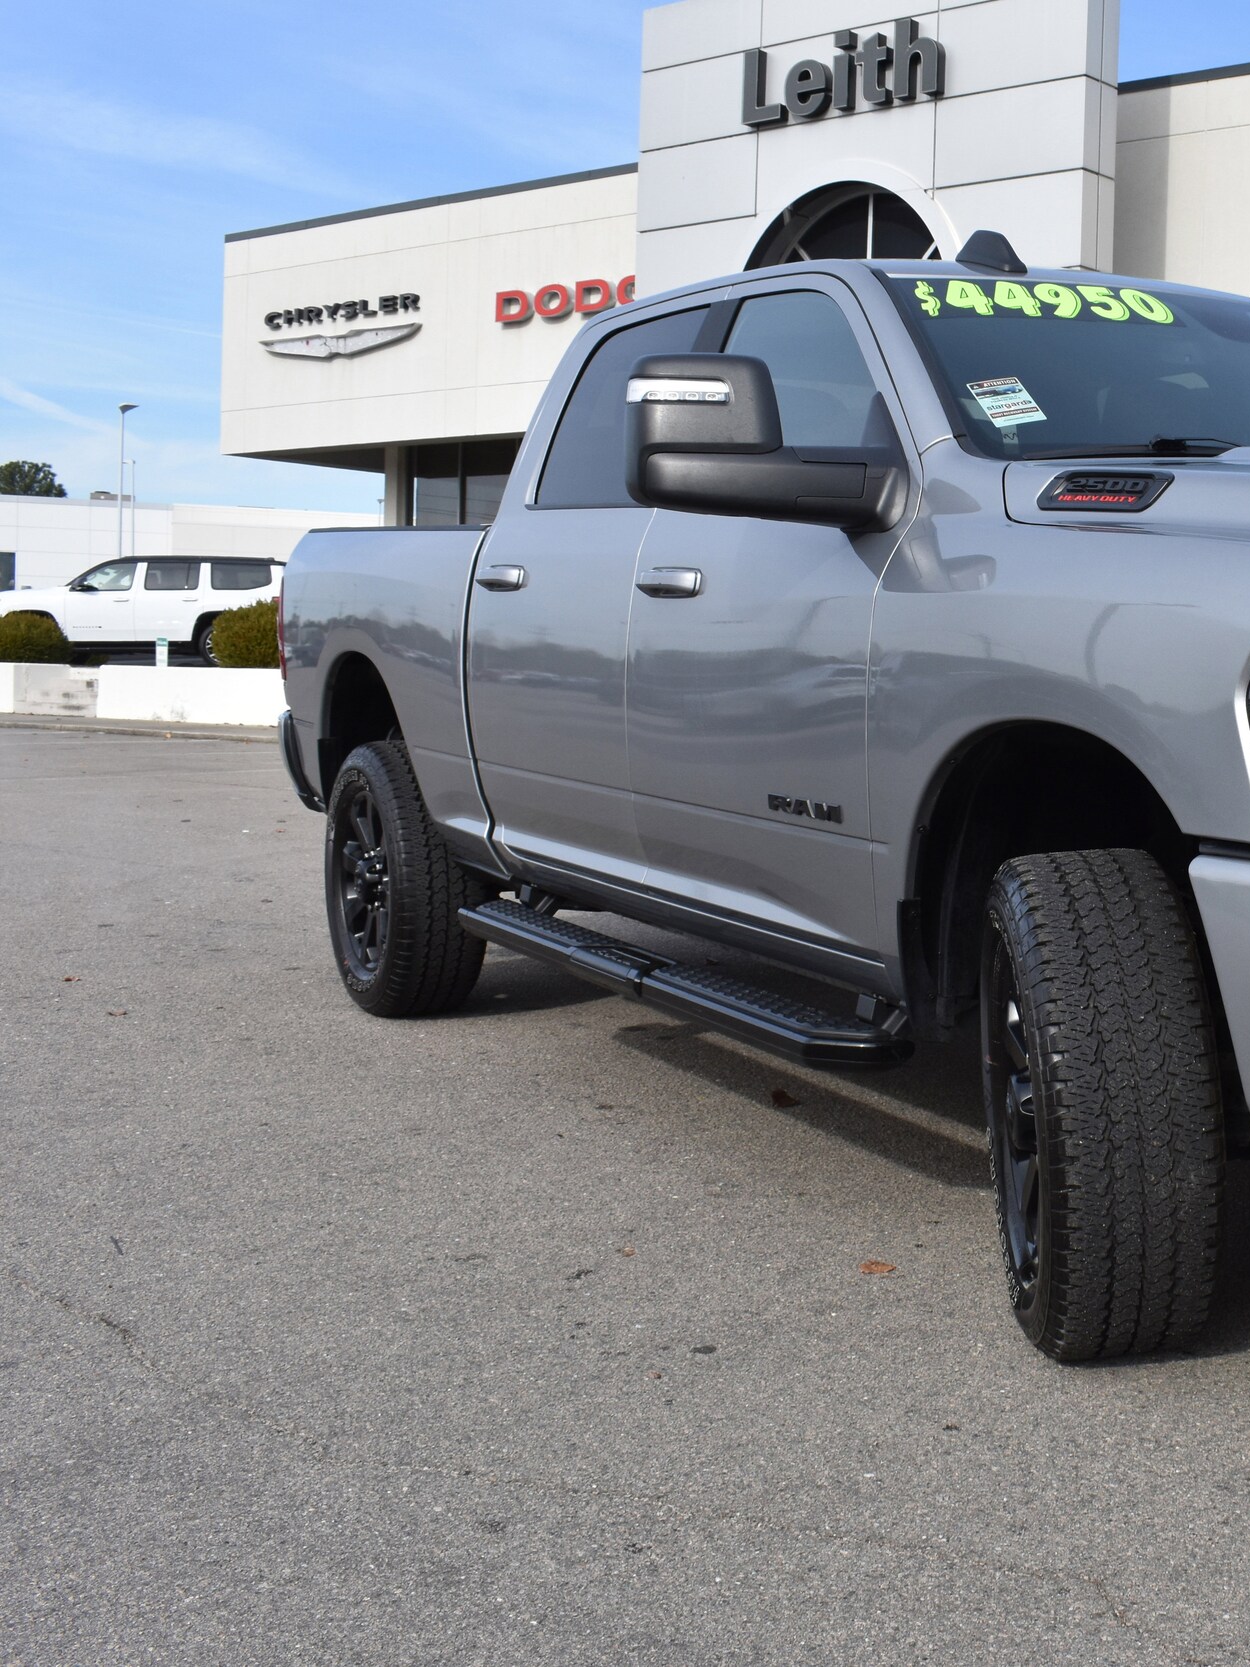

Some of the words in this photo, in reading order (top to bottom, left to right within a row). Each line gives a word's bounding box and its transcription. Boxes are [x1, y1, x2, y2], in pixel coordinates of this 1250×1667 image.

[742, 17, 946, 127] Leith
[264, 292, 421, 330] CHRYSLER
[914, 279, 1174, 324] $44950
[1057, 494, 1099, 502] HEAVY
[1099, 495, 1137, 504] DUTY
[1066, 479, 1146, 494] 2500
[767, 793, 843, 824] RAM
